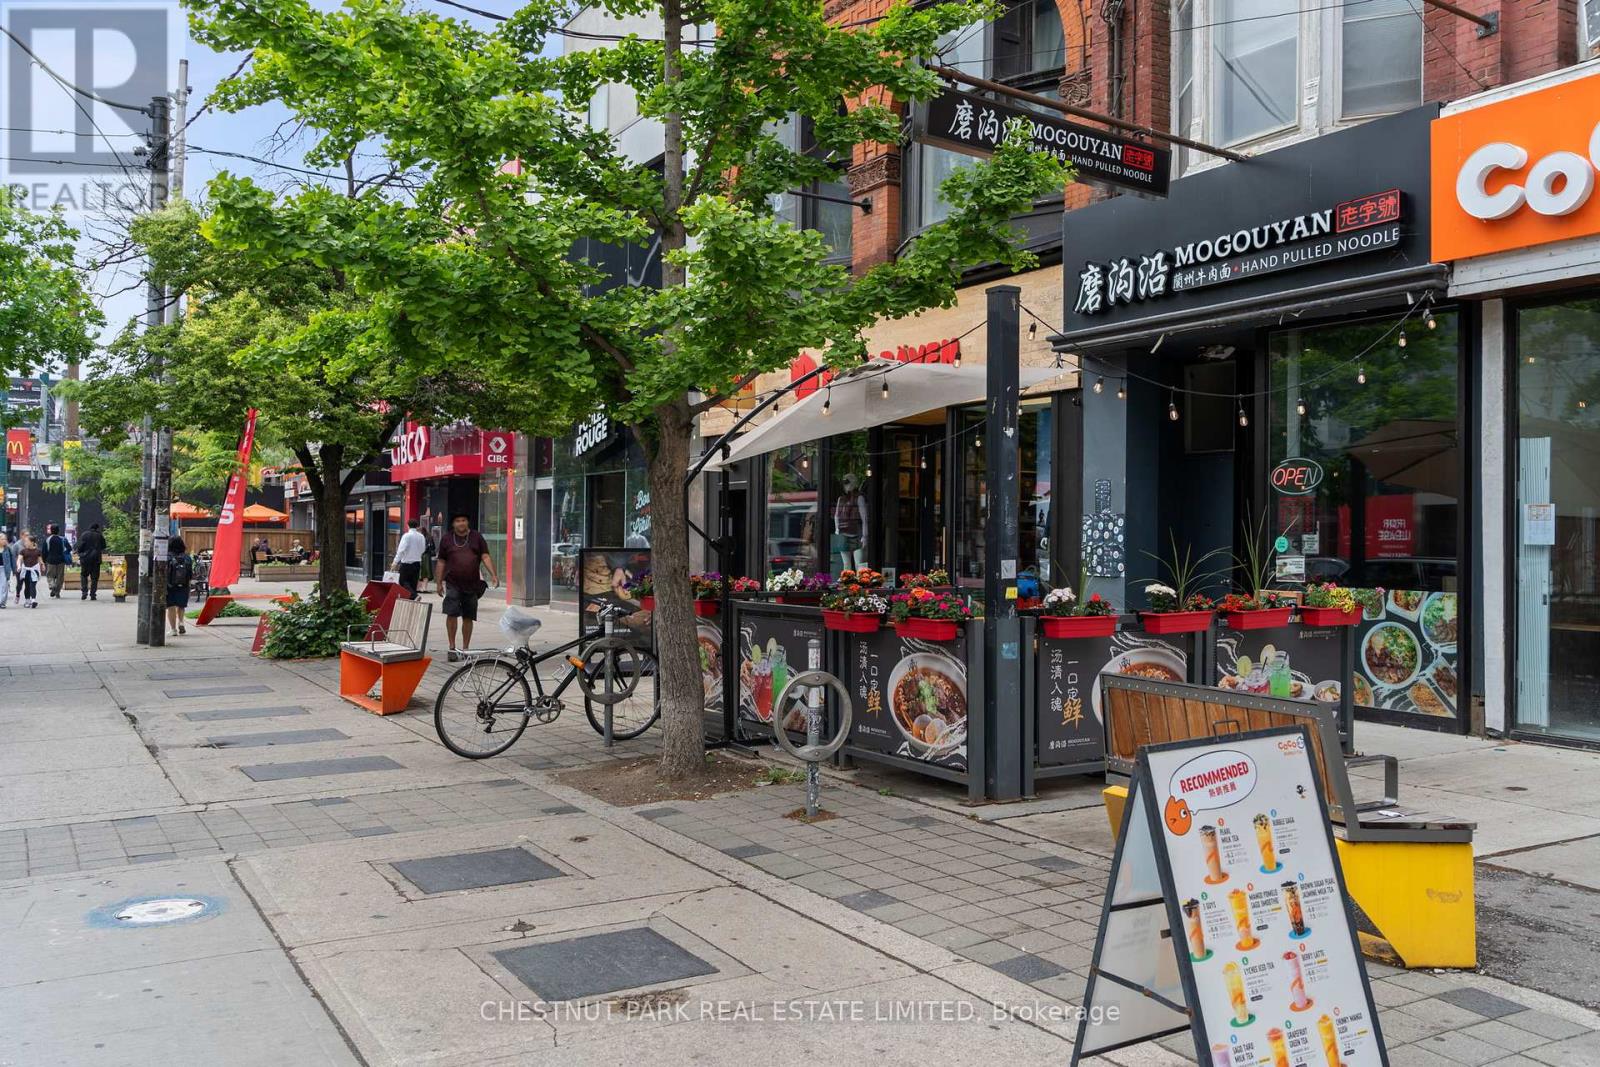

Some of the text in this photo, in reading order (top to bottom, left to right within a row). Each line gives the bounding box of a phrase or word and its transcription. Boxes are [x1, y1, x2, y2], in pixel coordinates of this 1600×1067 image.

[1029, 122, 1122, 161] MOGOUYAN
[1071, 155, 1152, 183] HAND PULLED NOODLE
[1456, 120, 1600, 219] Co
[1174, 209, 1334, 267] MOGOUYAN
[1241, 228, 1399, 273] HAND PULLED NOODLE
[575, 418, 608, 457] ROUGE
[487, 454, 508, 464] CIBC
[1273, 467, 1318, 487] OPEN
[1179, 761, 1249, 793] RECOMMENDED
